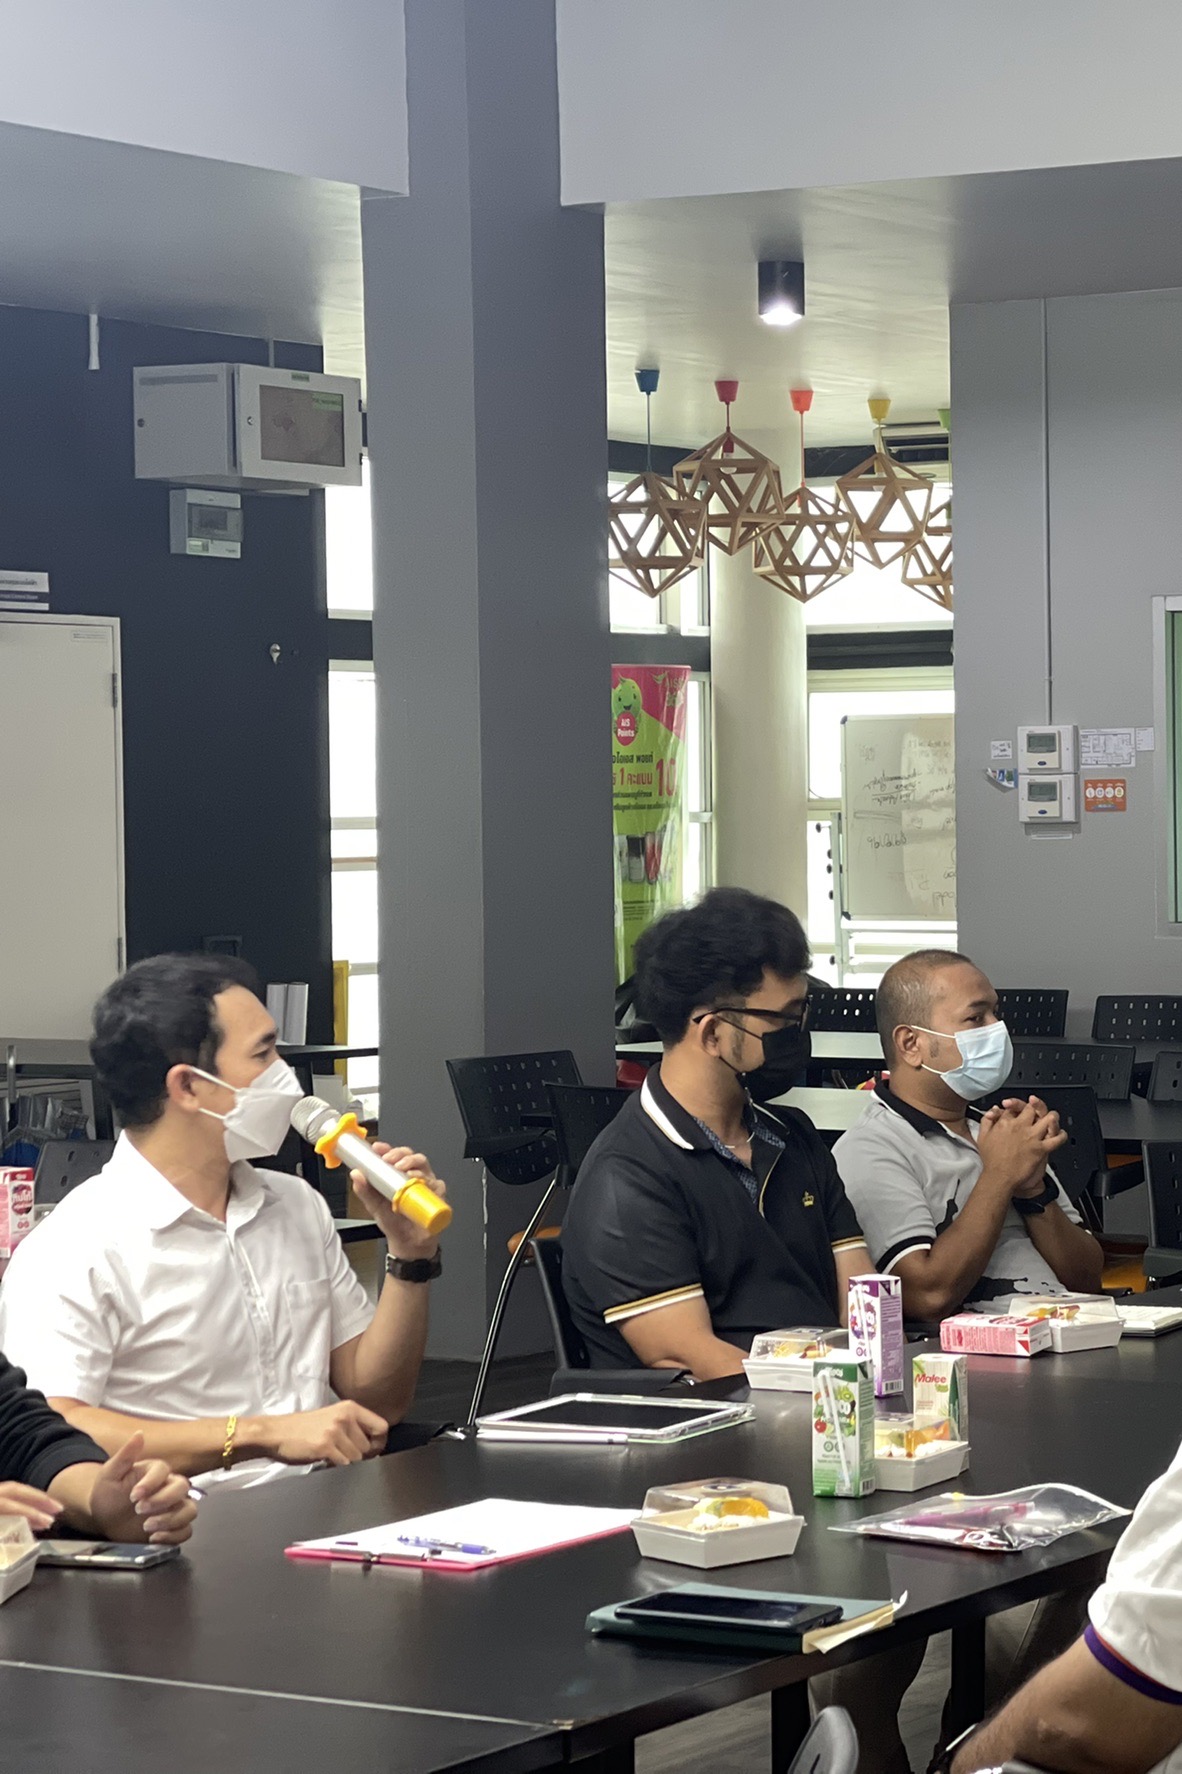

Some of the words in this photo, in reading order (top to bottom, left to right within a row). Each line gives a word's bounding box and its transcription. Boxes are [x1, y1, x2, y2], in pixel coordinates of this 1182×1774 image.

[621, 718, 630, 727] AIS
[617, 728, 634, 737] Points
[915, 1373, 947, 1384] Malee
